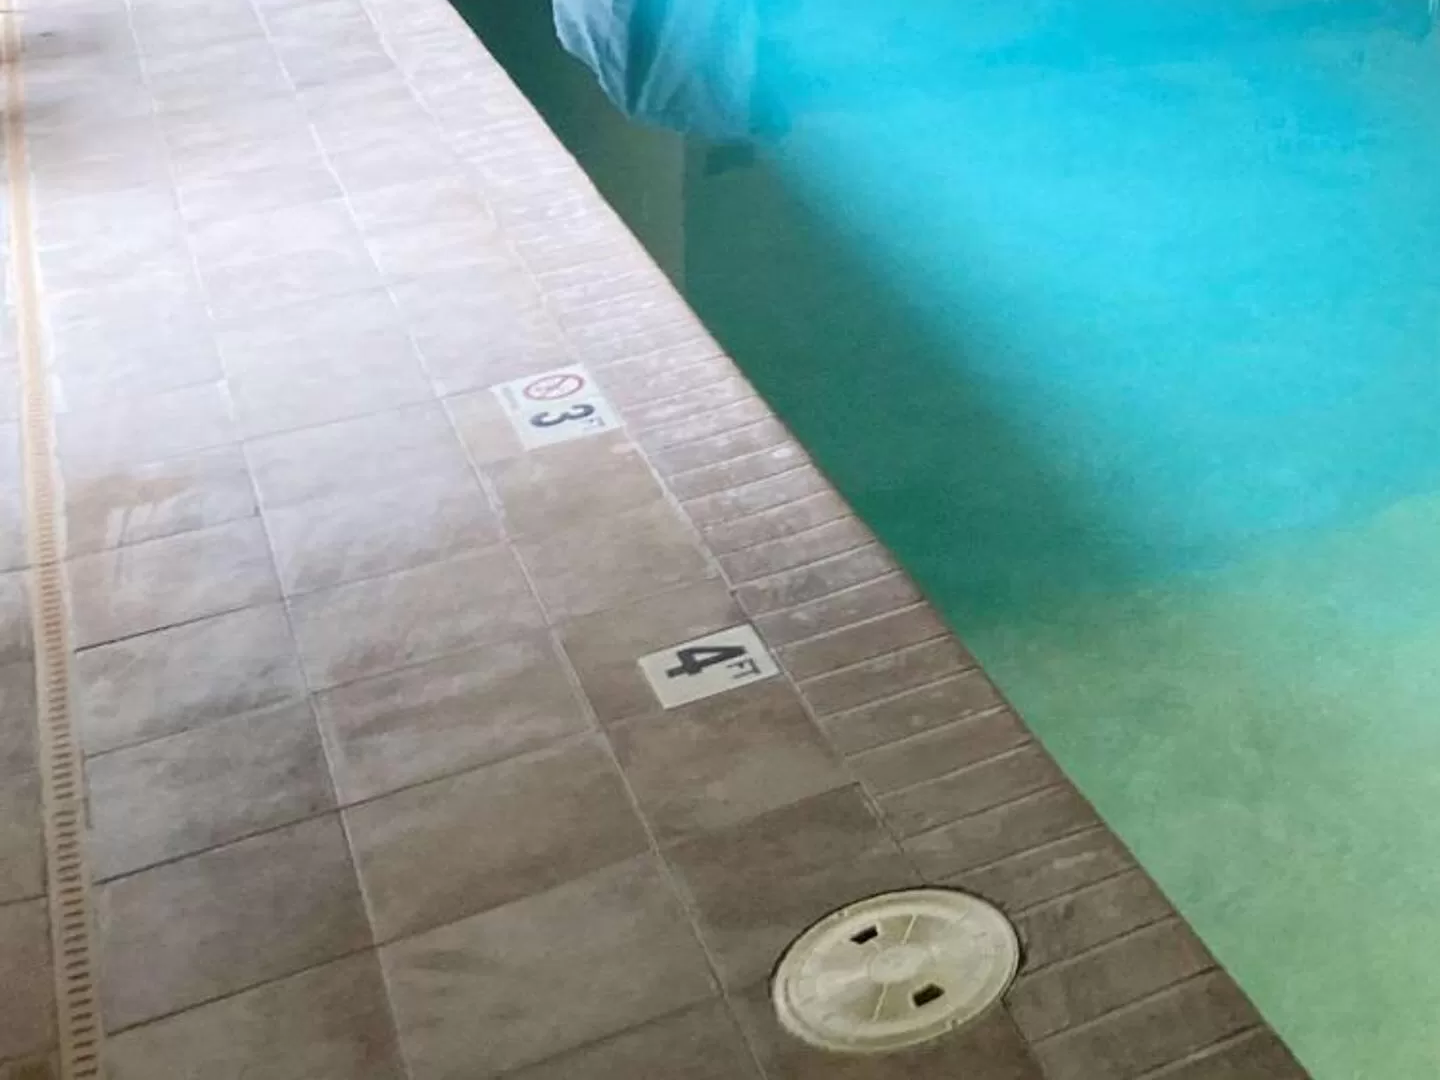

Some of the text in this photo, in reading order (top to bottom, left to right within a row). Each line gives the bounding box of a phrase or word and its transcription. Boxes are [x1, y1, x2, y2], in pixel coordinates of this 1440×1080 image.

[528, 403, 597, 428] 3
[665, 646, 761, 680] 4 FT
